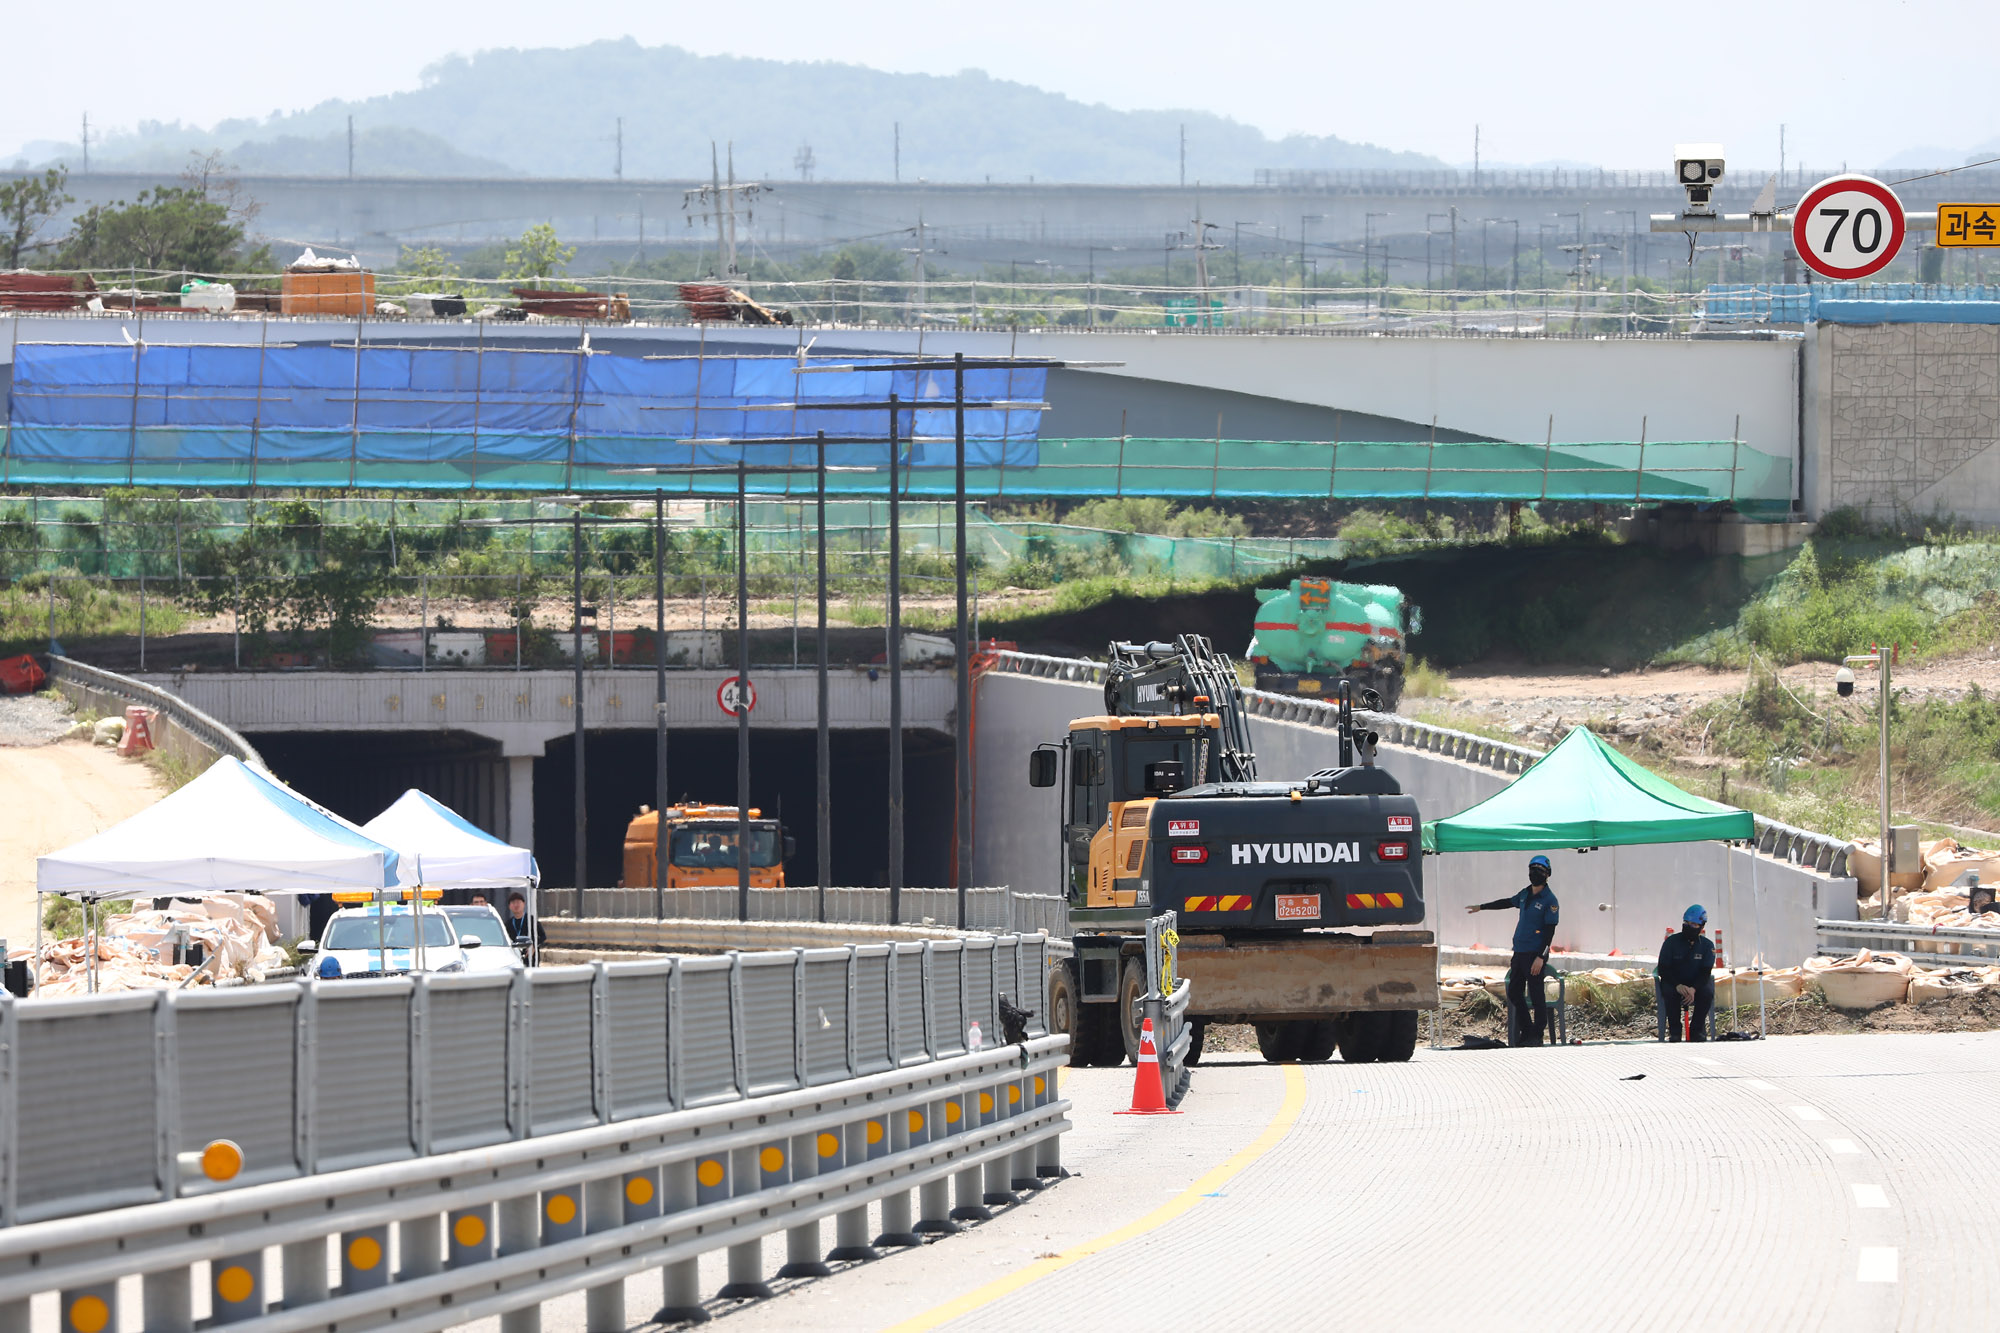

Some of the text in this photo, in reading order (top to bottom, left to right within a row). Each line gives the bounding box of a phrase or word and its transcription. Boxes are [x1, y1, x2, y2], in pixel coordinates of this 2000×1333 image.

[1819, 208, 1882, 254] 70
[1946, 211, 1997, 241] 과속
[1231, 842, 1360, 865] HYUNDAI
